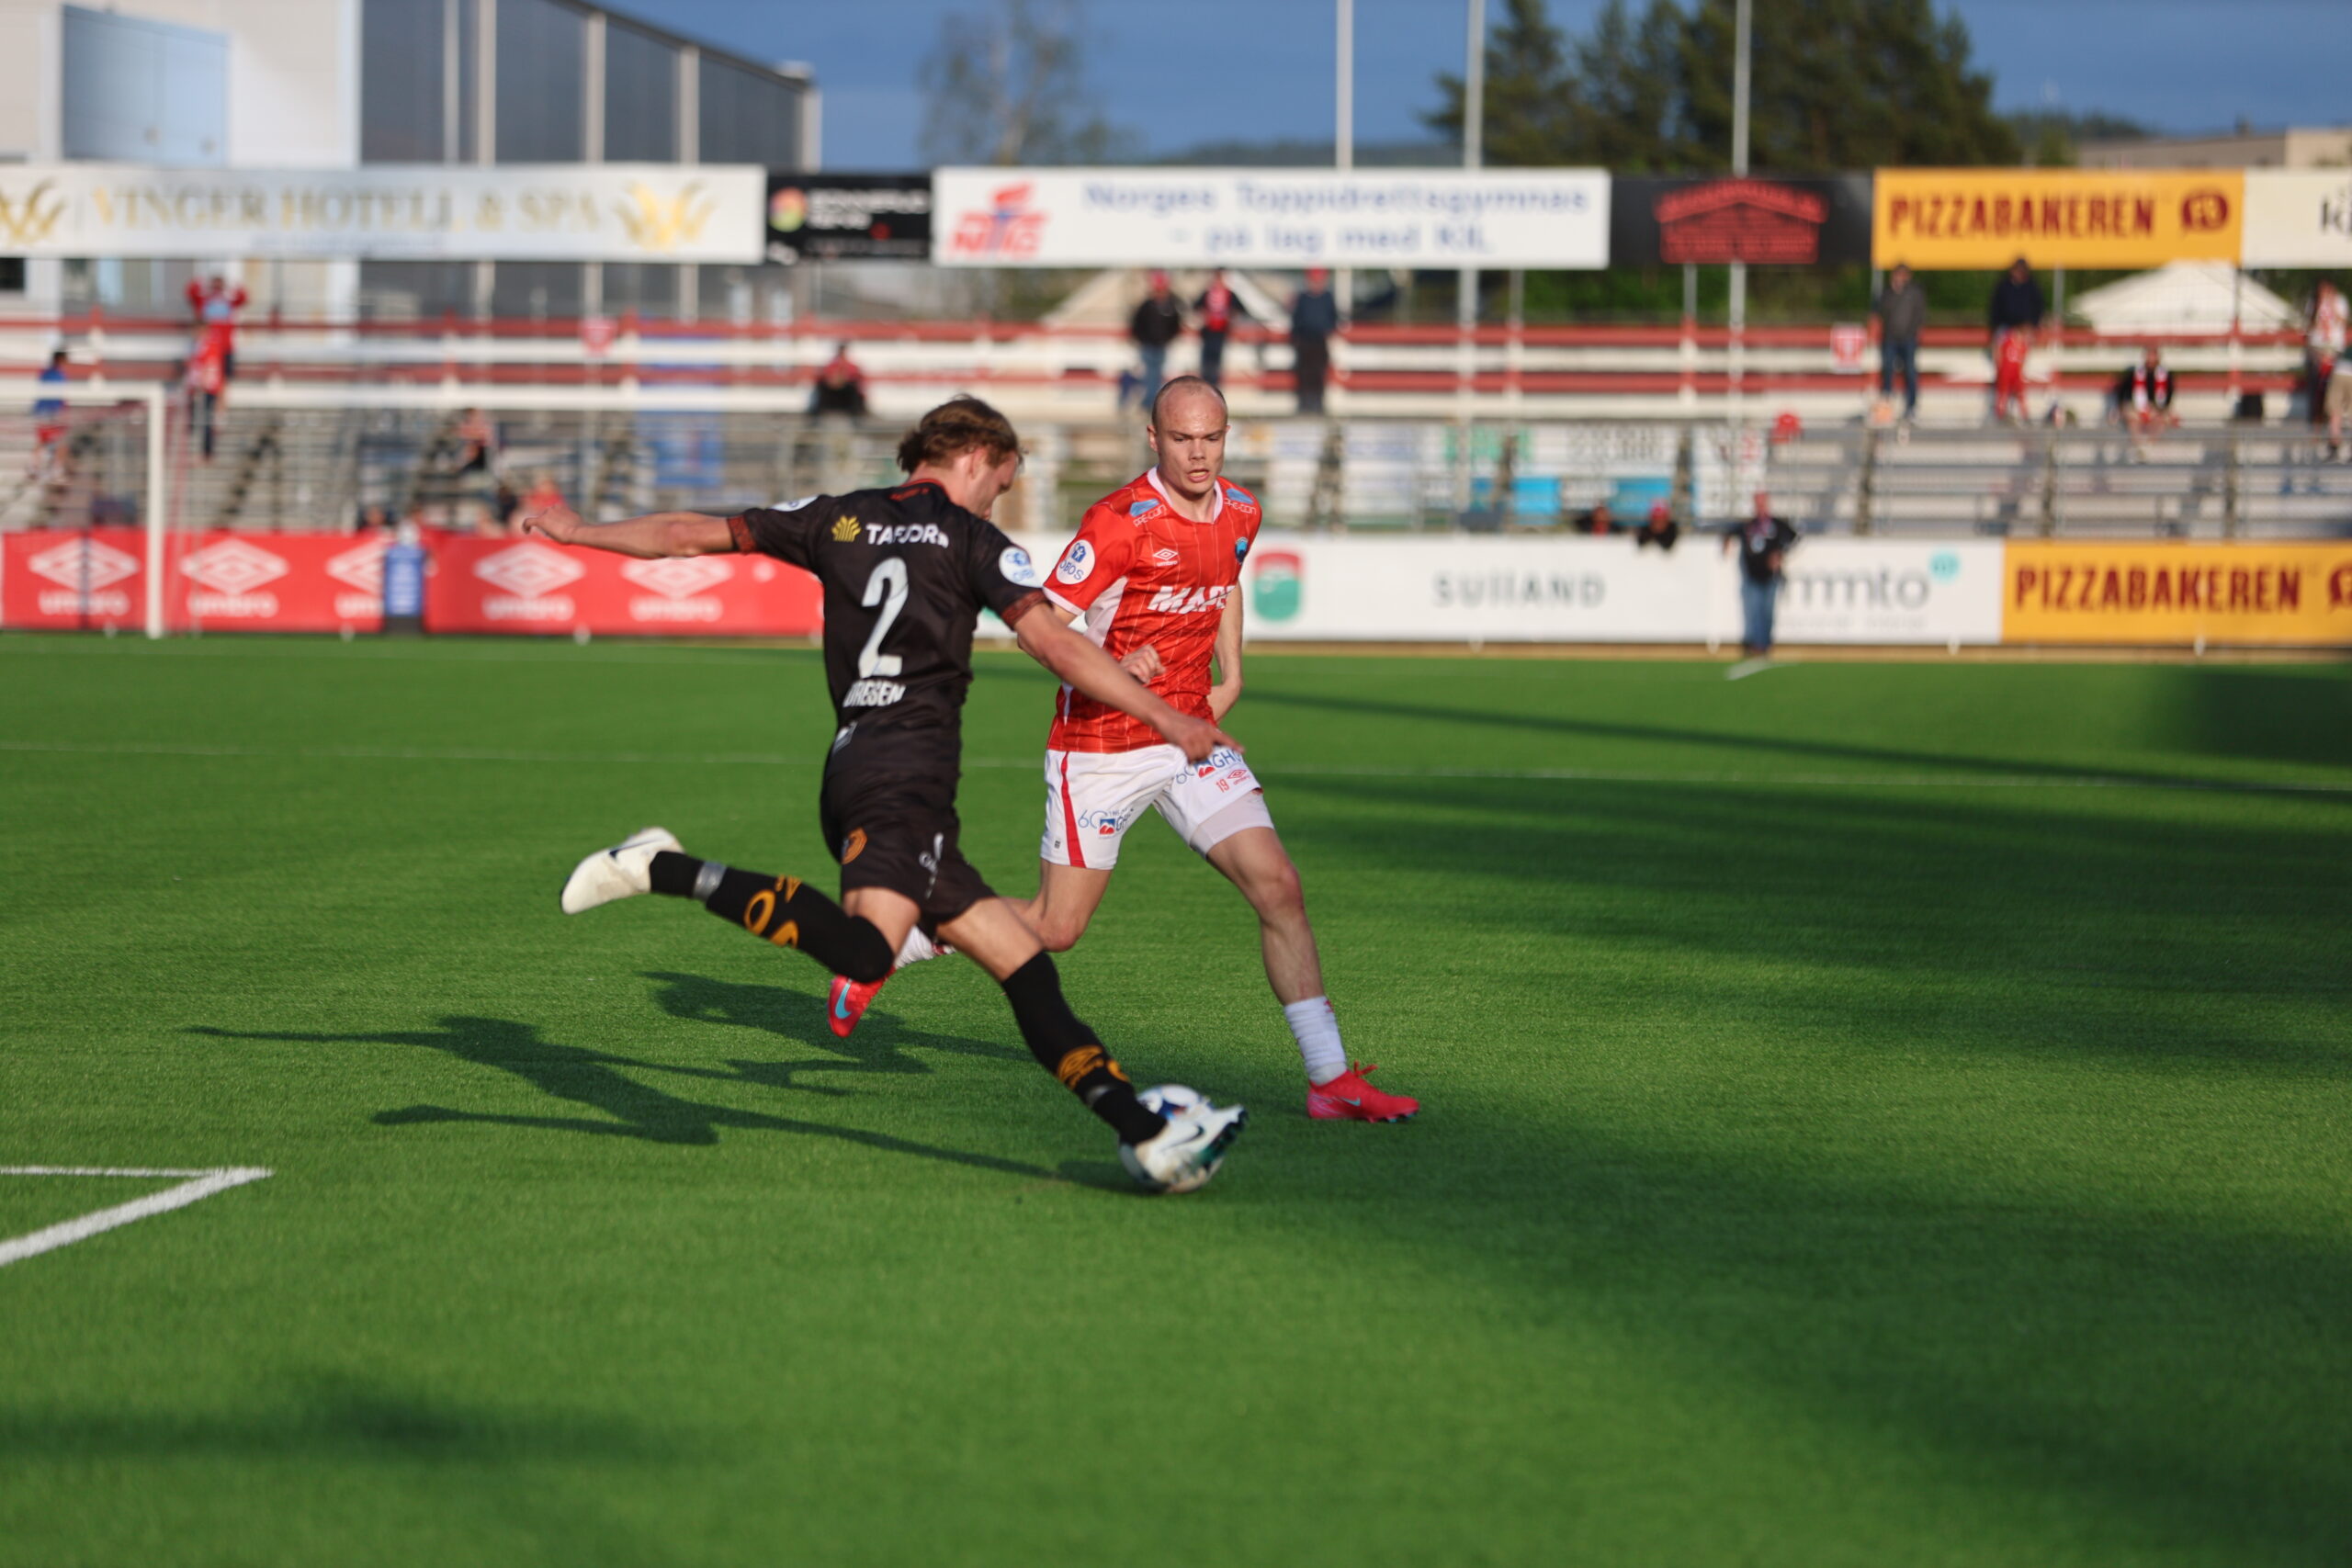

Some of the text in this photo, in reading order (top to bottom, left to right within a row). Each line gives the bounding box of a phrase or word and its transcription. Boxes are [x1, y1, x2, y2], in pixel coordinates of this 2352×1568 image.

[93, 186, 268, 229] VINGER
[517, 188, 604, 231] SPA
[1087, 181, 1588, 219] Norges Toppidrettsgymnas
[1889, 195, 2155, 239] PIZZABAKEREN
[1205, 224, 1251, 259] på
[1266, 224, 1324, 259] lag
[1339, 226, 1419, 254] med
[1059, 558, 1084, 581] OBOS
[2015, 564, 2299, 612] PIZZABAKEREN
[482, 595, 575, 620] umbro
[858, 557, 909, 679] 2
[1216, 778, 1230, 793] 19
